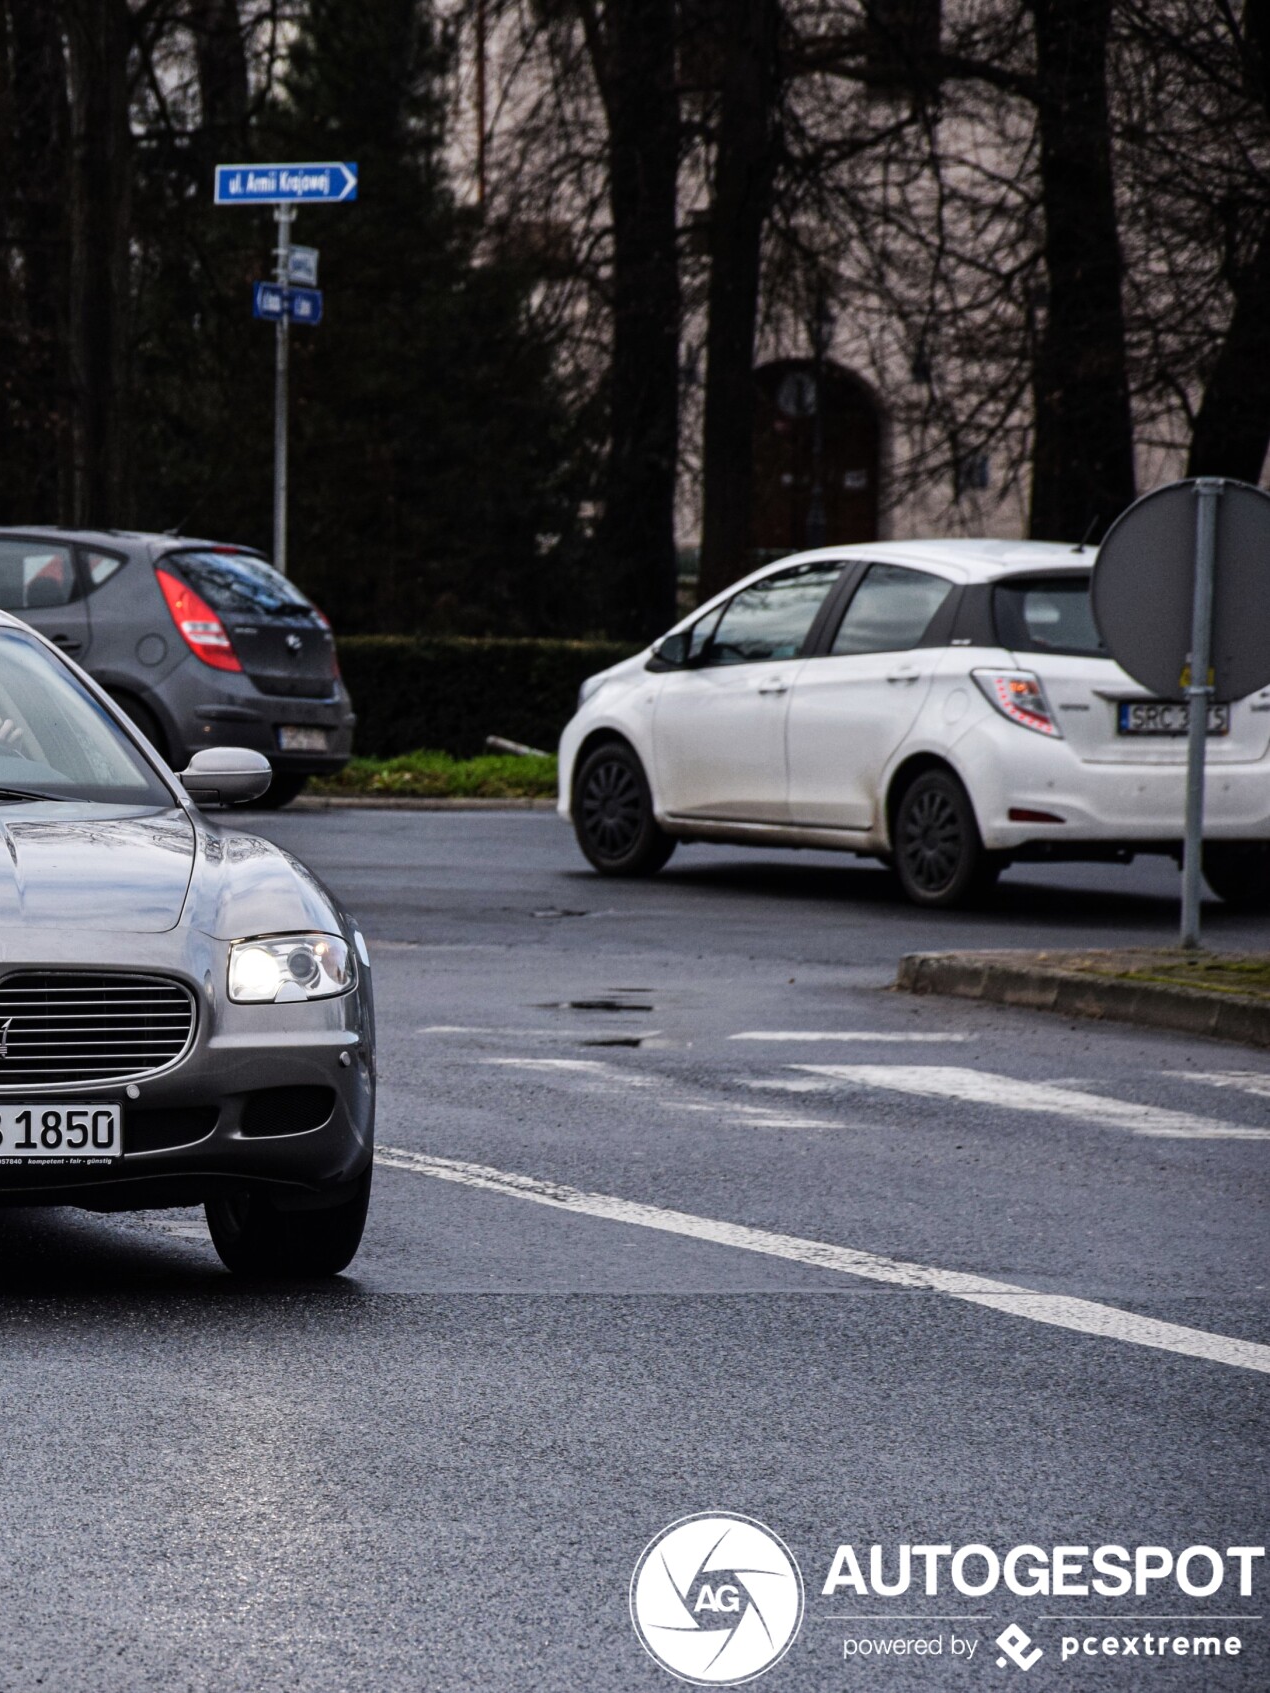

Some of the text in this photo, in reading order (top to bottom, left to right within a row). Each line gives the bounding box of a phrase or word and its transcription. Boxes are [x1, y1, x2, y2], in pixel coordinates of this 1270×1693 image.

[229, 168, 330, 197] ul. Armii Krajowej
[1133, 706, 1173, 729] SRC
[15, 1110, 115, 1149] 1850
[27, 1157, 65, 1166] kompetent
[70, 1157, 81, 1165] fair
[87, 1157, 112, 1166] günstig
